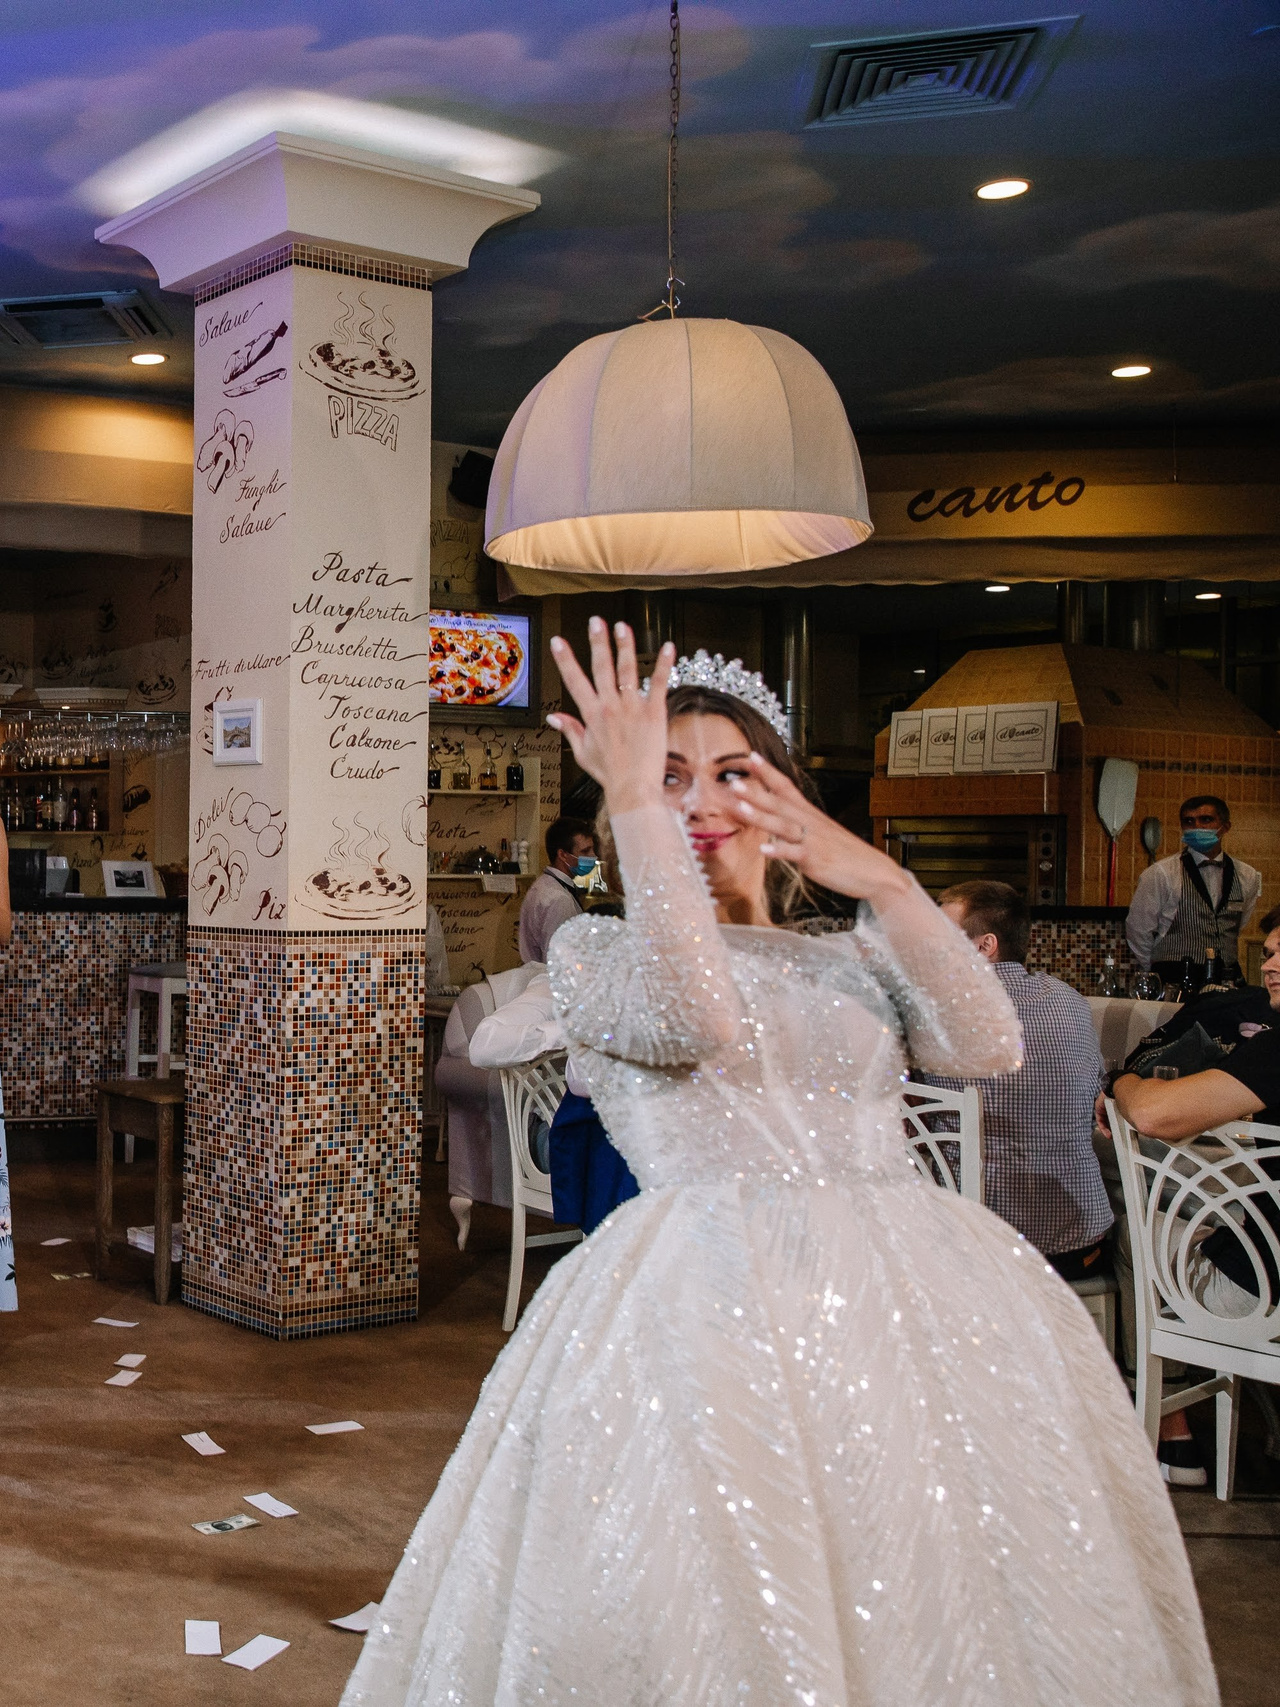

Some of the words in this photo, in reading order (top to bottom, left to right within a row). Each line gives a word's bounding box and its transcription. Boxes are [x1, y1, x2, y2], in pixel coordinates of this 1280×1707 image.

[328, 395, 399, 452] PIZZA
[235, 469, 287, 511] Funghi
[907, 471, 1085, 522] canto
[312, 551, 413, 587] Pasta
[293, 593, 428, 634] Margherita
[291, 622, 427, 661] Bruschetta
[191, 659, 231, 679] Frutti
[234, 658, 246, 673] di
[301, 659, 427, 700] Capriciosa
[324, 694, 427, 722] Toscana
[329, 723, 417, 750] Calzone
[330, 753, 400, 779] Crudo
[194, 787, 234, 843] Dolci
[429, 819, 480, 839] Pasta
[434, 904, 490, 917] Toscana
[441, 920, 484, 934] alzone
[445, 940, 475, 952] rudo
